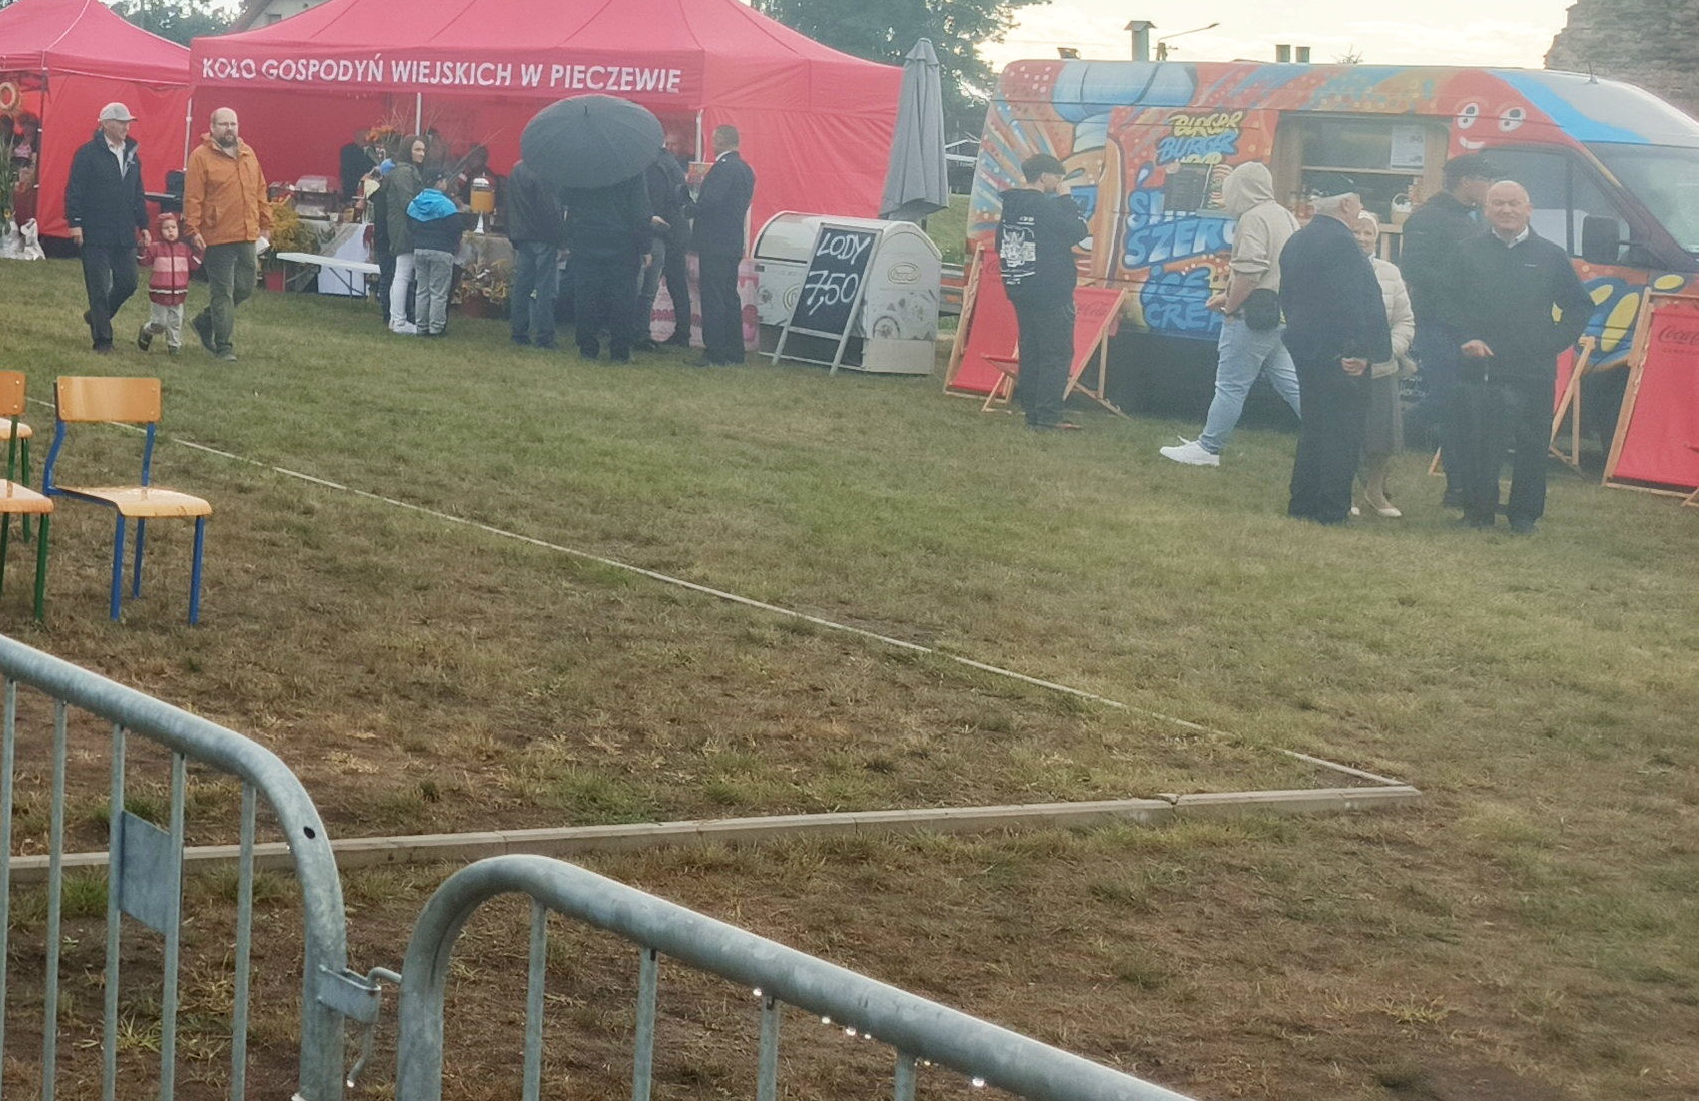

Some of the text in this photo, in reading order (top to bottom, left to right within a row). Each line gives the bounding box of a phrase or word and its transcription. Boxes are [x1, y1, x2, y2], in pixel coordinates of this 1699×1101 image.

[202, 53, 682, 93] KOŁO GOSPODYŃ WIEJSKICH W PIECZEWIE
[816, 232, 872, 266] LODY
[804, 270, 859, 316] 7,50
